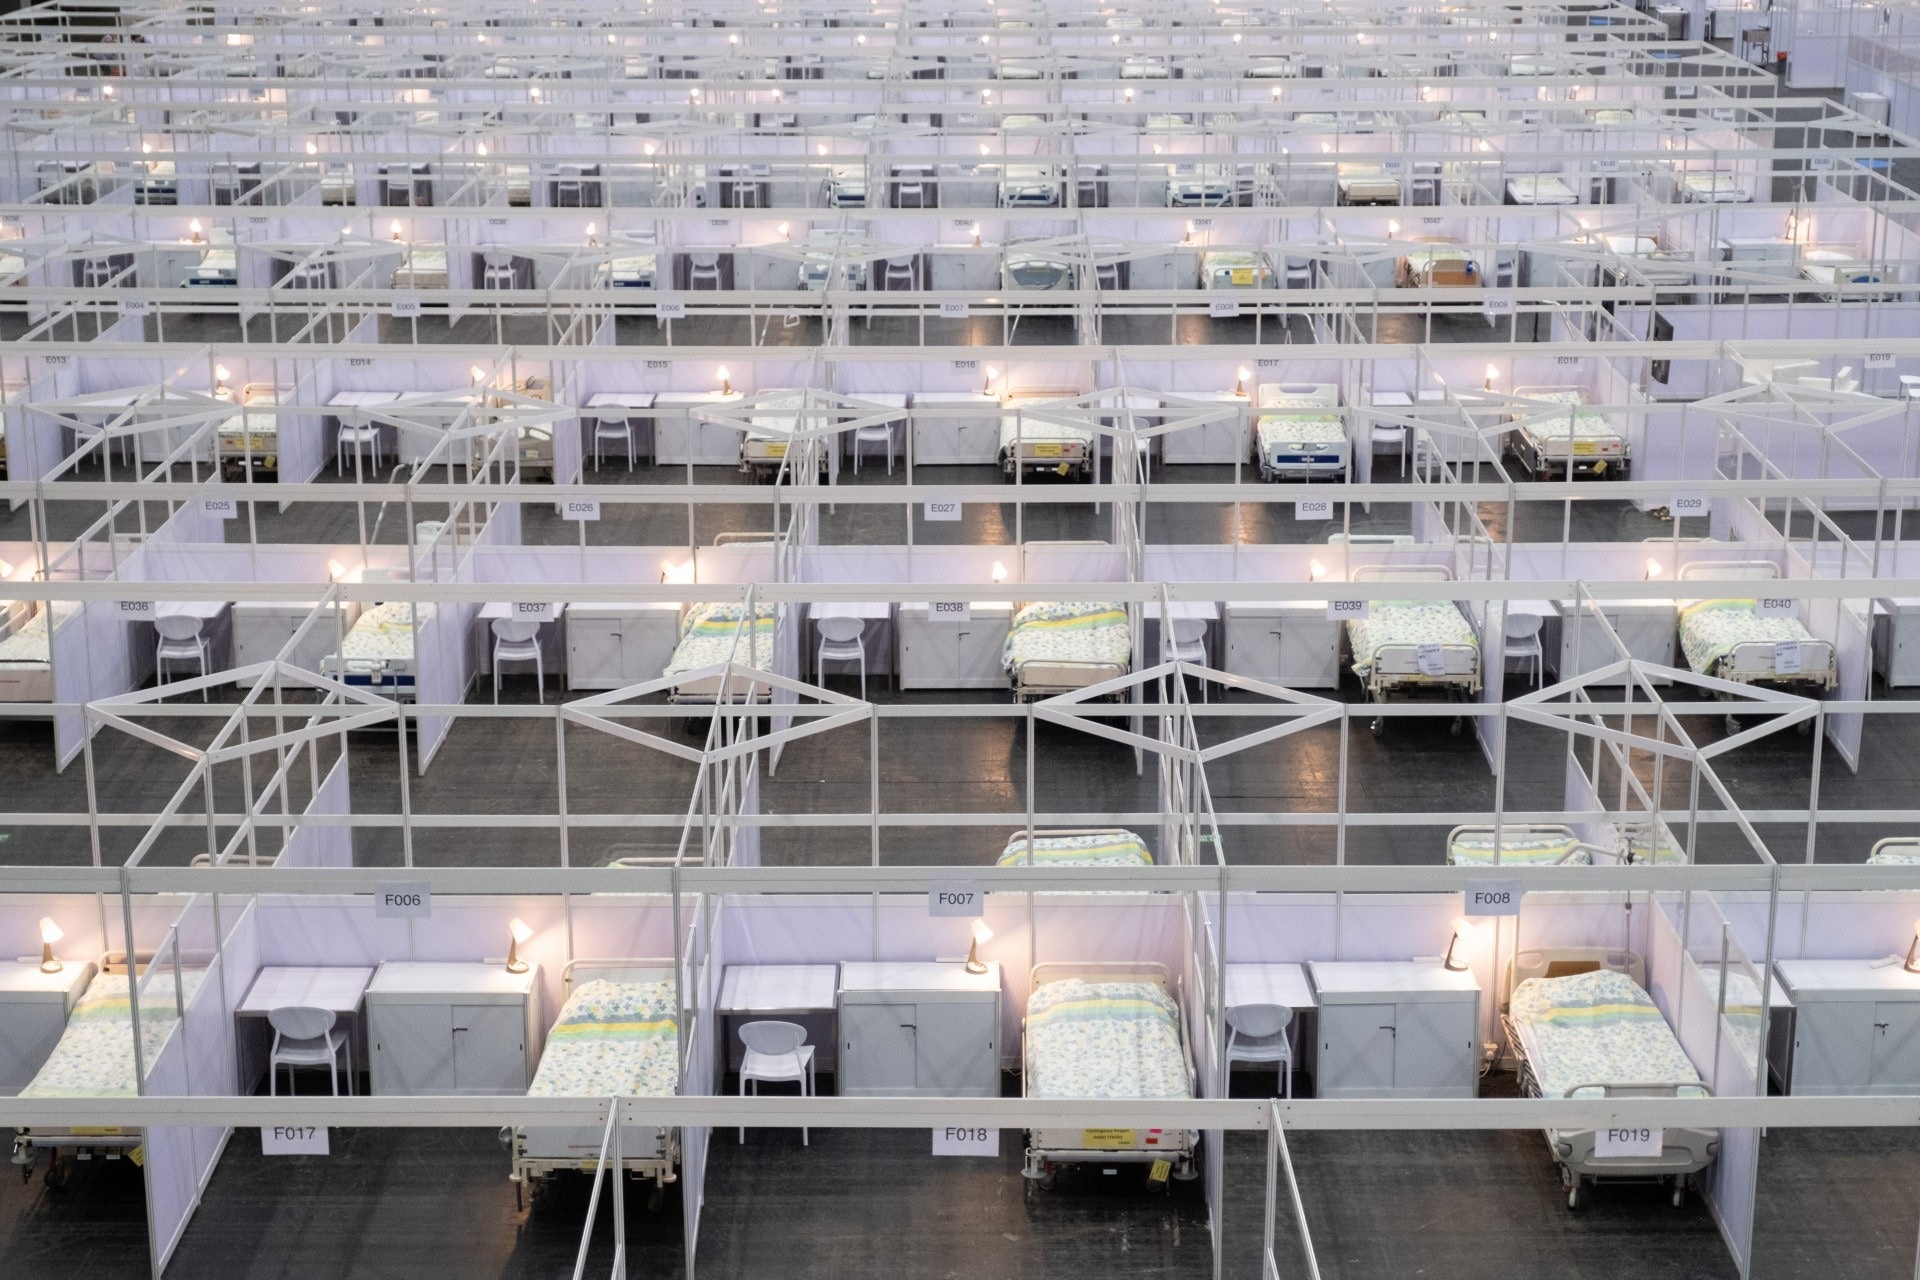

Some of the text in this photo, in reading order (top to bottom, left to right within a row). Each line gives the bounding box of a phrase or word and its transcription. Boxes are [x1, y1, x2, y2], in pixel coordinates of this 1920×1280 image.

[125, 301, 144, 309] E004
[396, 302, 415, 310] E005
[1489, 300, 1508, 308] E009
[45, 356, 66, 364] E013
[1557, 356, 1578, 364] E018
[1869, 353, 1890, 361] E019
[647, 360, 668, 368] E015
[955, 360, 975, 368] E016
[1257, 359, 1278, 367] E017
[205, 501, 230, 510] E025
[568, 502, 593, 511] E026
[931, 503, 956, 512] E027
[1302, 502, 1327, 511] E028
[1677, 499, 1701, 508] E029
[121, 601, 148, 611] E036
[519, 602, 546, 612] E037
[936, 602, 963, 612] E038
[1334, 600, 1361, 610] E039
[1763, 599, 1791, 608] E040
[385, 894, 421, 906] F006
[939, 893, 974, 905] F007
[1475, 892, 1510, 903] F008
[274, 1127, 316, 1140] F017
[945, 1128, 987, 1141] F018
[1608, 1128, 1650, 1142] F019
